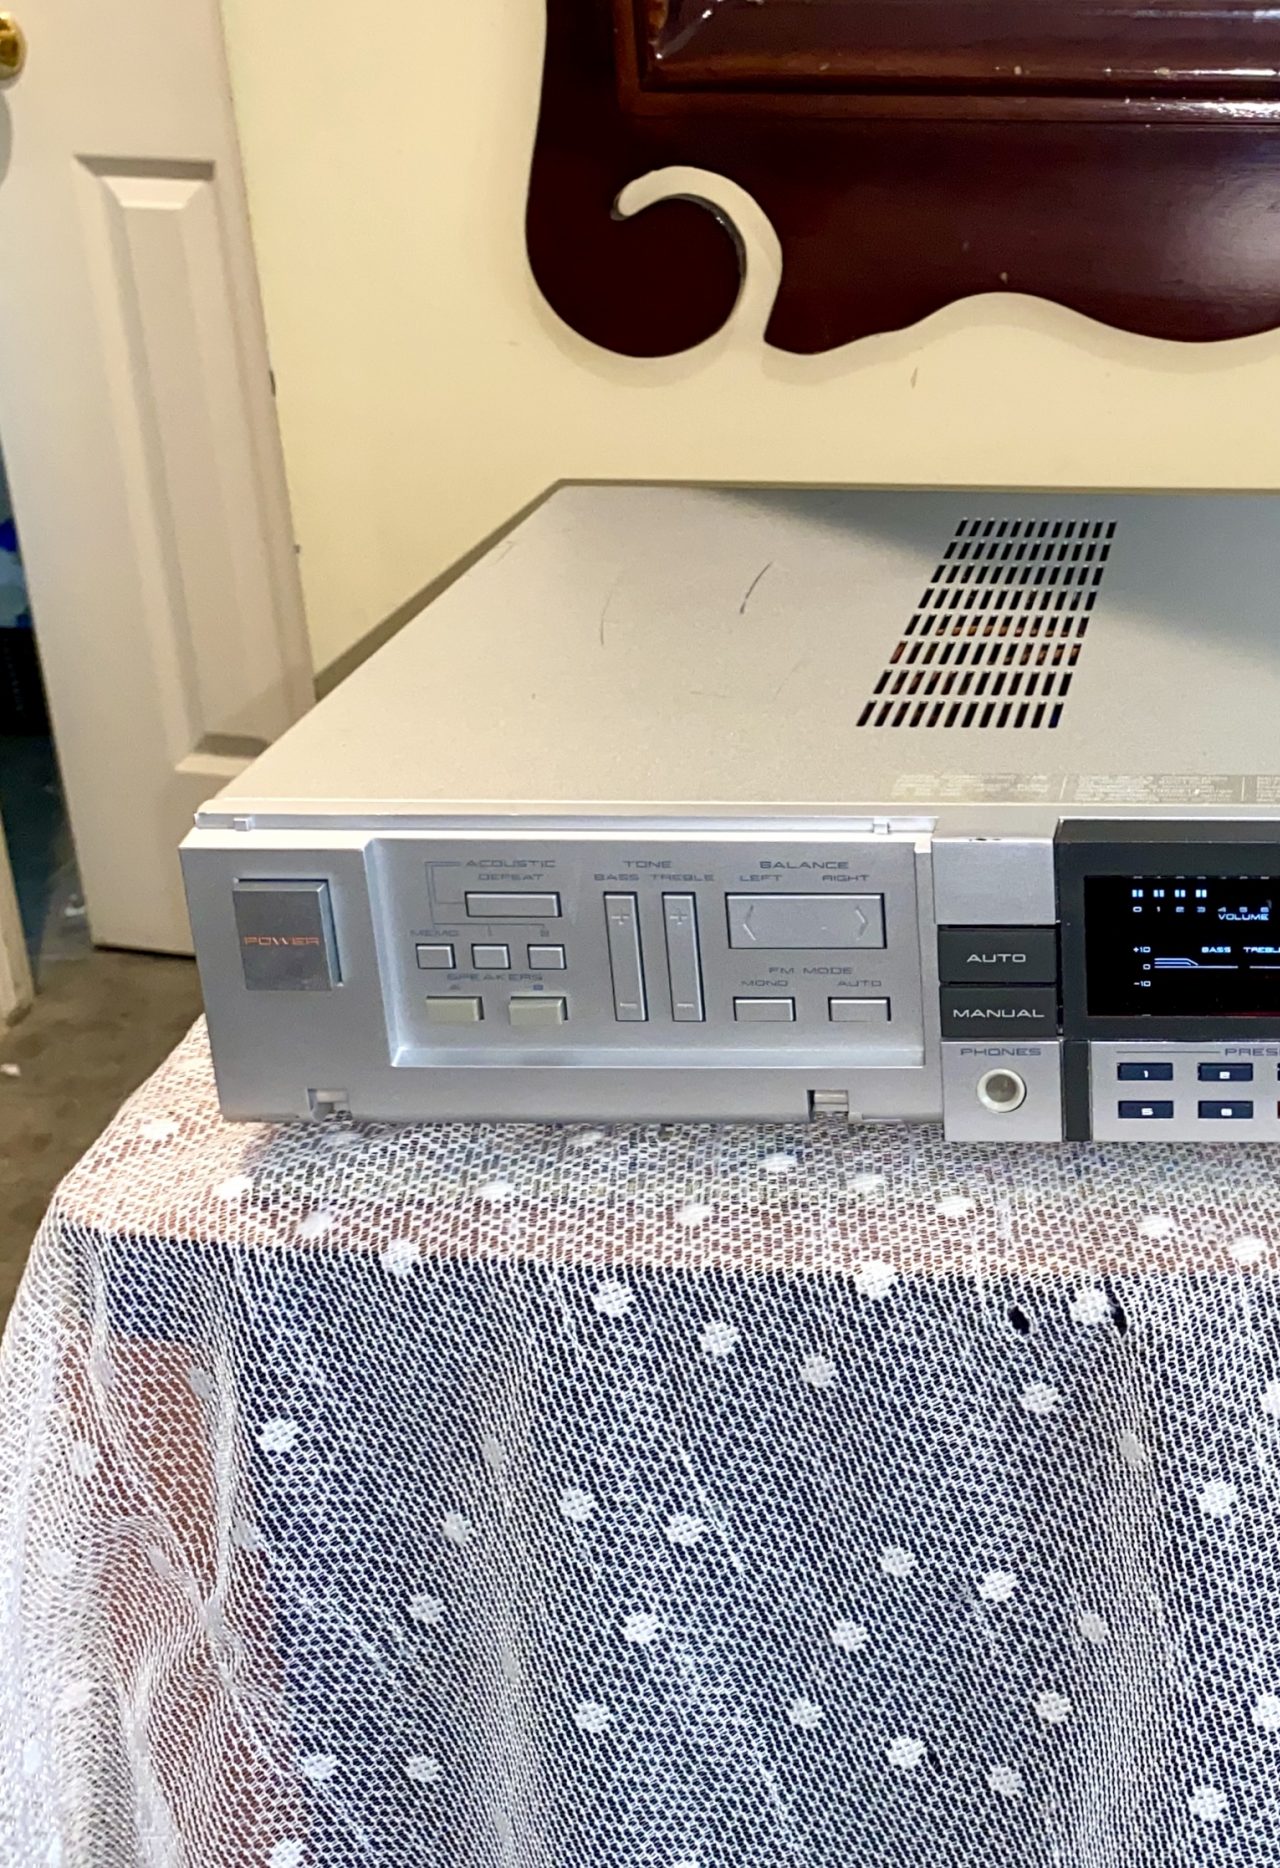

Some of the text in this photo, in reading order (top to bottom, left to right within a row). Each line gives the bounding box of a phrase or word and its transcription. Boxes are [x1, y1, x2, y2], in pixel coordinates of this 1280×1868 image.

[466, 859, 556, 868] ACOUSTIC
[623, 860, 672, 869] TONE
[759, 860, 849, 870] BALANCE
[593, 873, 714, 881] BASS TREBLE
[739, 874, 783, 882] LEFT
[822, 874, 870, 882] RIGHT
[1217, 913, 1270, 921] VOLUME
[410, 929, 459, 938] MEMO
[244, 936, 320, 946] POWER
[1201, 946, 1232, 954] BASS
[966, 953, 1027, 963] AUTO
[768, 967, 853, 975] FM MODE
[446, 973, 543, 981] SPEAKERS
[741, 979, 789, 988] MONO
[837, 979, 882, 988] AUTO
[953, 1009, 1045, 1018] MANUAL
[960, 1047, 1042, 1056] PHONES
[1219, 1071, 1230, 1080] 2
[1141, 1107, 1154, 1117] 5
